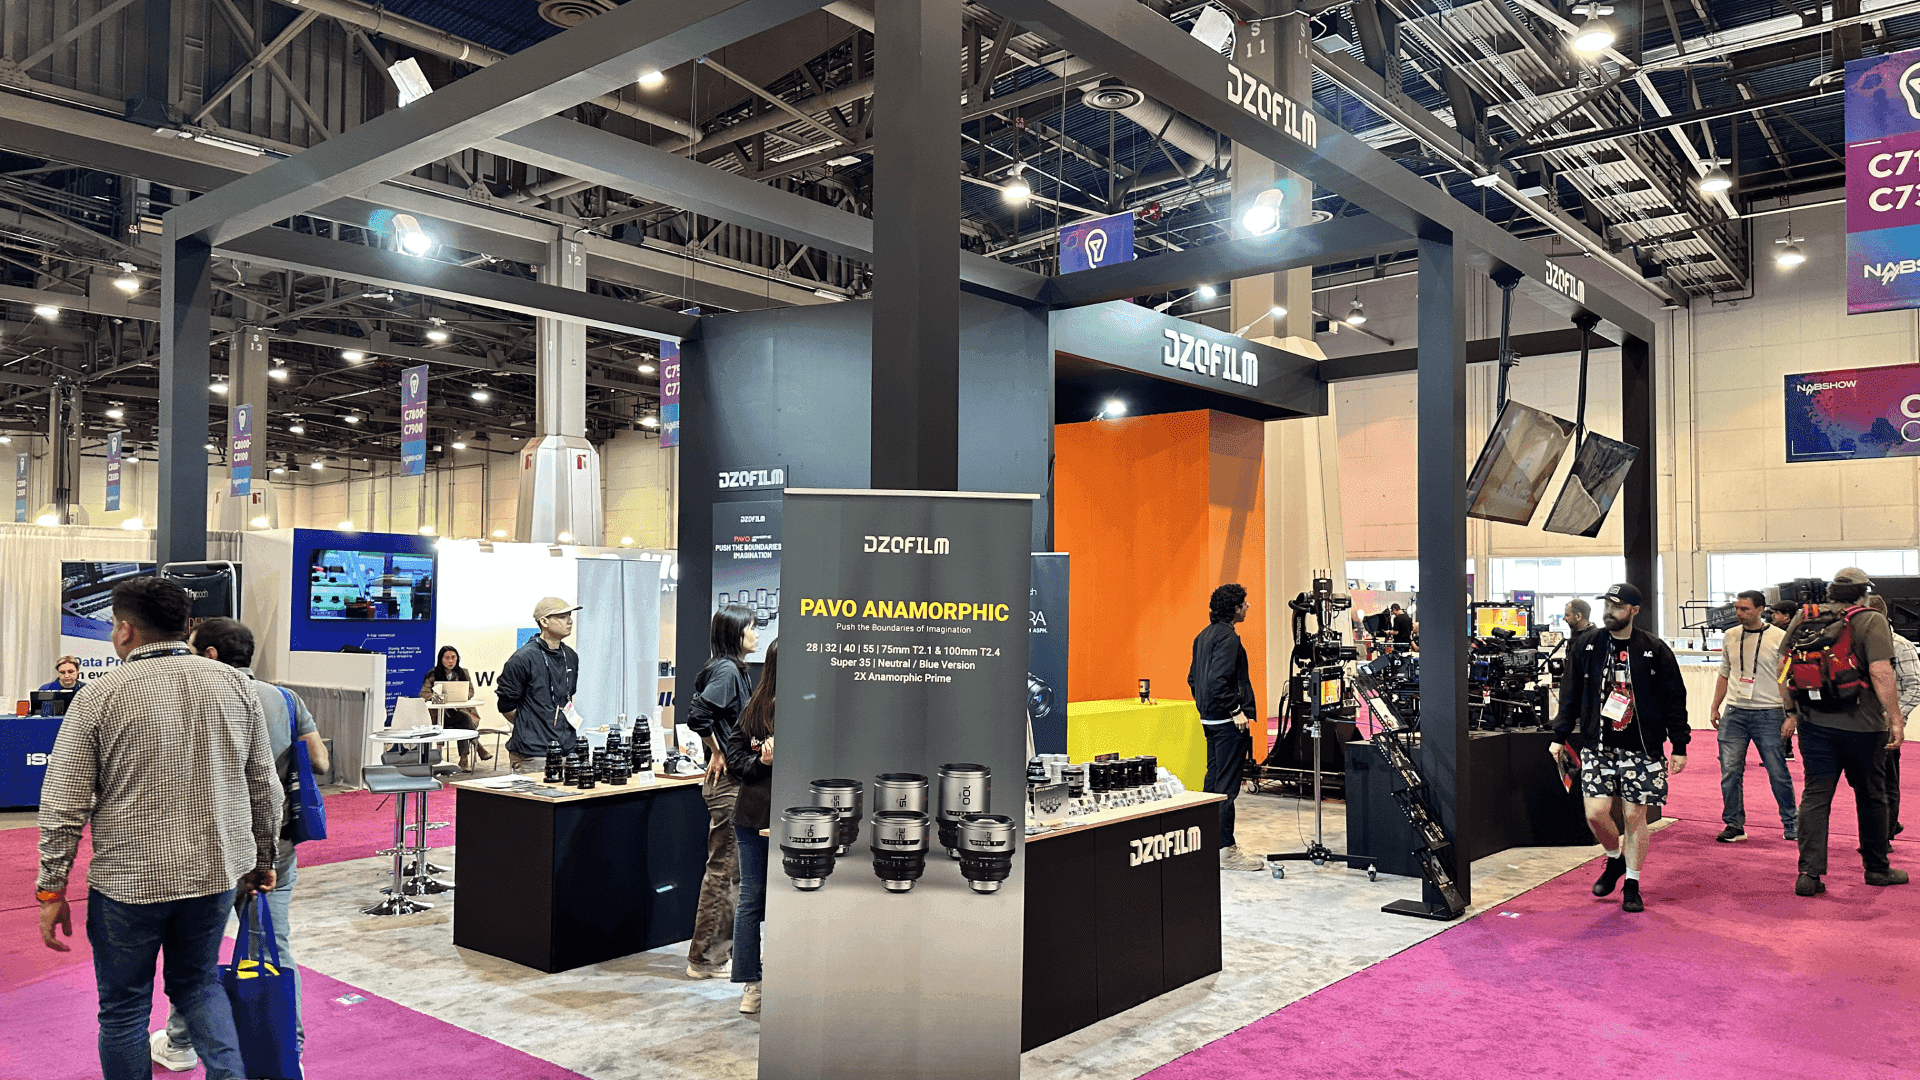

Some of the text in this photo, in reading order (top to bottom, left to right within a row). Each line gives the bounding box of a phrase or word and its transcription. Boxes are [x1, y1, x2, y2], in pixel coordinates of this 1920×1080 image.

[1251, 22, 1261, 36] S
[1227, 63, 1317, 149] DZOFILM
[1163, 327, 1258, 388] DZOFILM
[719, 468, 784, 488] DZOFILM
[863, 535, 950, 555] DZOFILM
[800, 598, 1010, 623] PAVO ANAMORPHIC
[836, 622, 972, 635] Push the Boundaries of Imagination
[806, 643, 818, 652] 28
[824, 643, 837, 652] 32
[843, 644, 856, 653] 40
[862, 645, 875, 654] 55
[881, 645, 911, 655] 75mm
[912, 645, 932, 655] T2.1
[934, 646, 942, 655] &
[943, 646, 978, 656] 100mm
[980, 647, 1001, 657] T2.4
[830, 657, 858, 669] Super
[858, 658, 871, 667] 35
[877, 658, 911, 669] Neutral
[919, 660, 940, 669] Blue
[941, 660, 976, 670] Version
[853, 671, 952, 684] 2X Anamorphic Prime
[1129, 825, 1202, 867] DZOFILM
